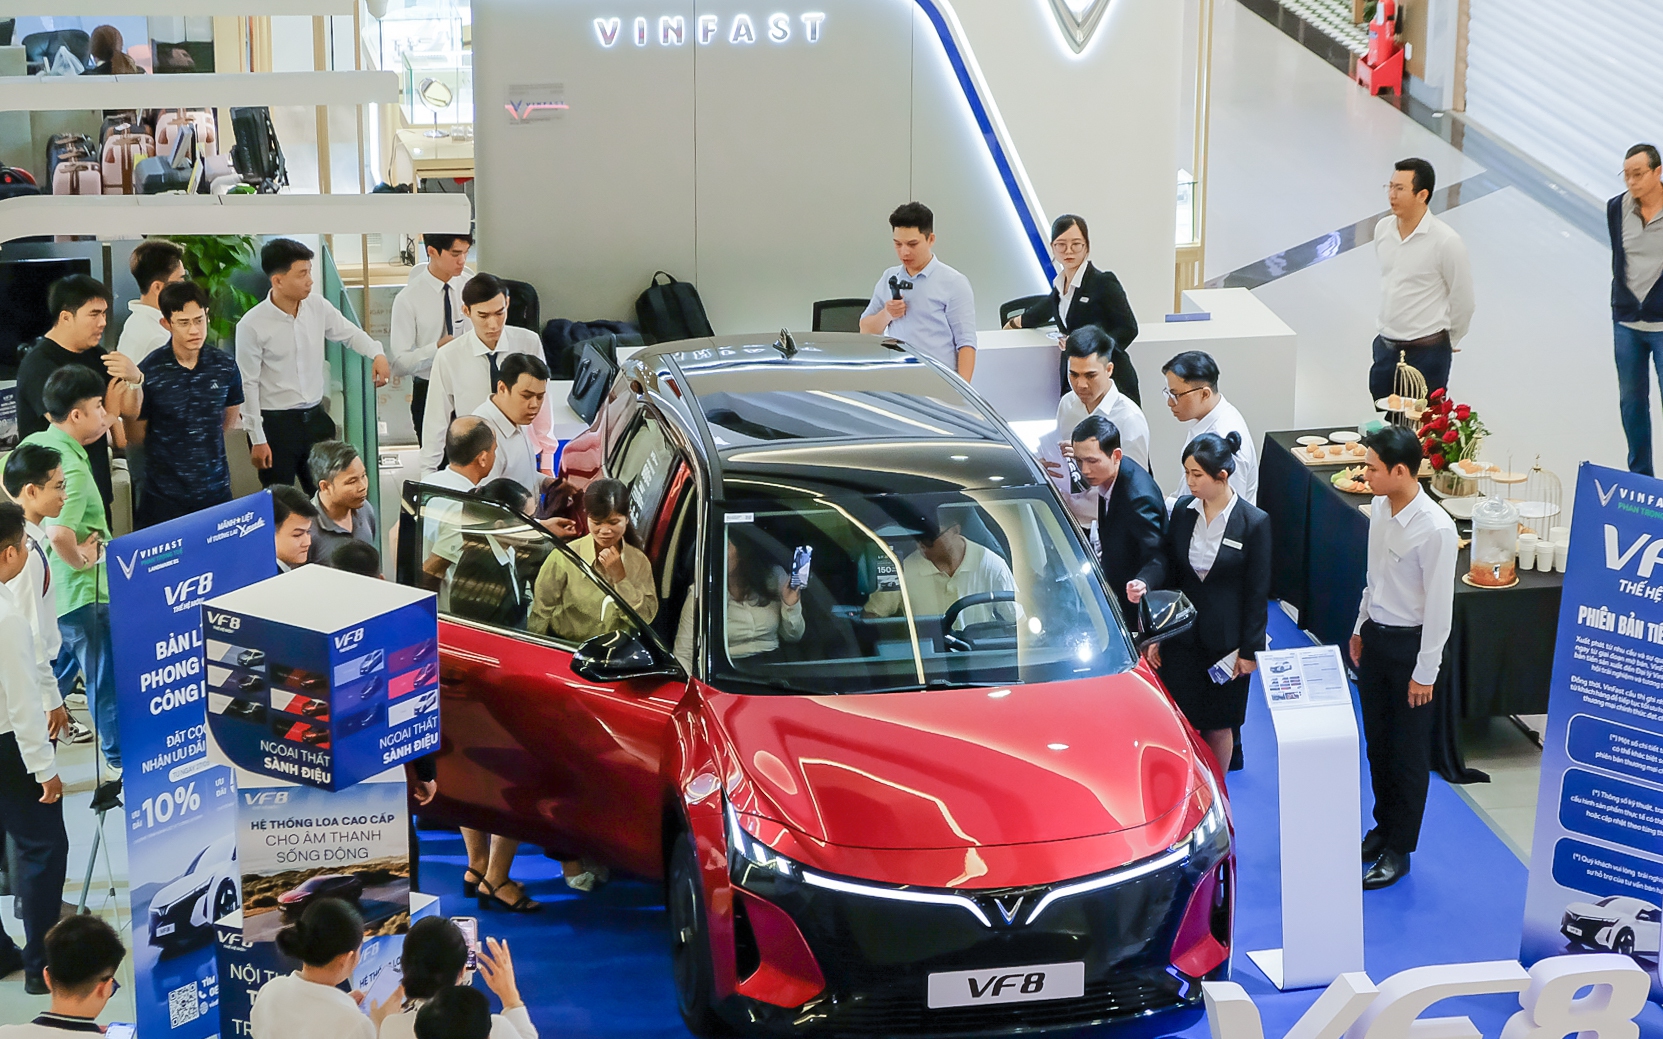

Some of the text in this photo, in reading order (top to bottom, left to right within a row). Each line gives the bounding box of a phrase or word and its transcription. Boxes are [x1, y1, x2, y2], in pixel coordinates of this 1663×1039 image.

[594, 13, 826, 47] VINFAST
[140, 538, 183, 559] VINFAST
[164, 571, 214, 606] VF8
[207, 611, 241, 630] VF8
[1577, 605, 1616, 632] PHIÊN
[1617, 611, 1645, 640] BẢN
[156, 632, 190, 661] BẢN
[334, 627, 364, 650] VF8
[140, 656, 200, 697] PHONG
[148, 683, 199, 717] CÔNG
[166, 730, 187, 748] ĐẶT
[379, 714, 438, 751] NGOẠI THẤT
[260, 740, 332, 769] NGOẠI THẤT
[382, 730, 439, 765] SÀNH ĐIỆU
[141, 752, 172, 774] NHẬN
[263, 756, 332, 784] SÀNH ĐIỆU
[142, 781, 201, 828] 10%
[244, 791, 289, 806] VF8
[251, 811, 396, 831] HỆ THỐNG LOA CAO CẤP
[265, 830, 382, 847] CHO ÂM THANH
[276, 845, 370, 863] SỐNG ĐỘNG
[230, 962, 261, 985] NỘI
[967, 972, 1046, 999] VF8
